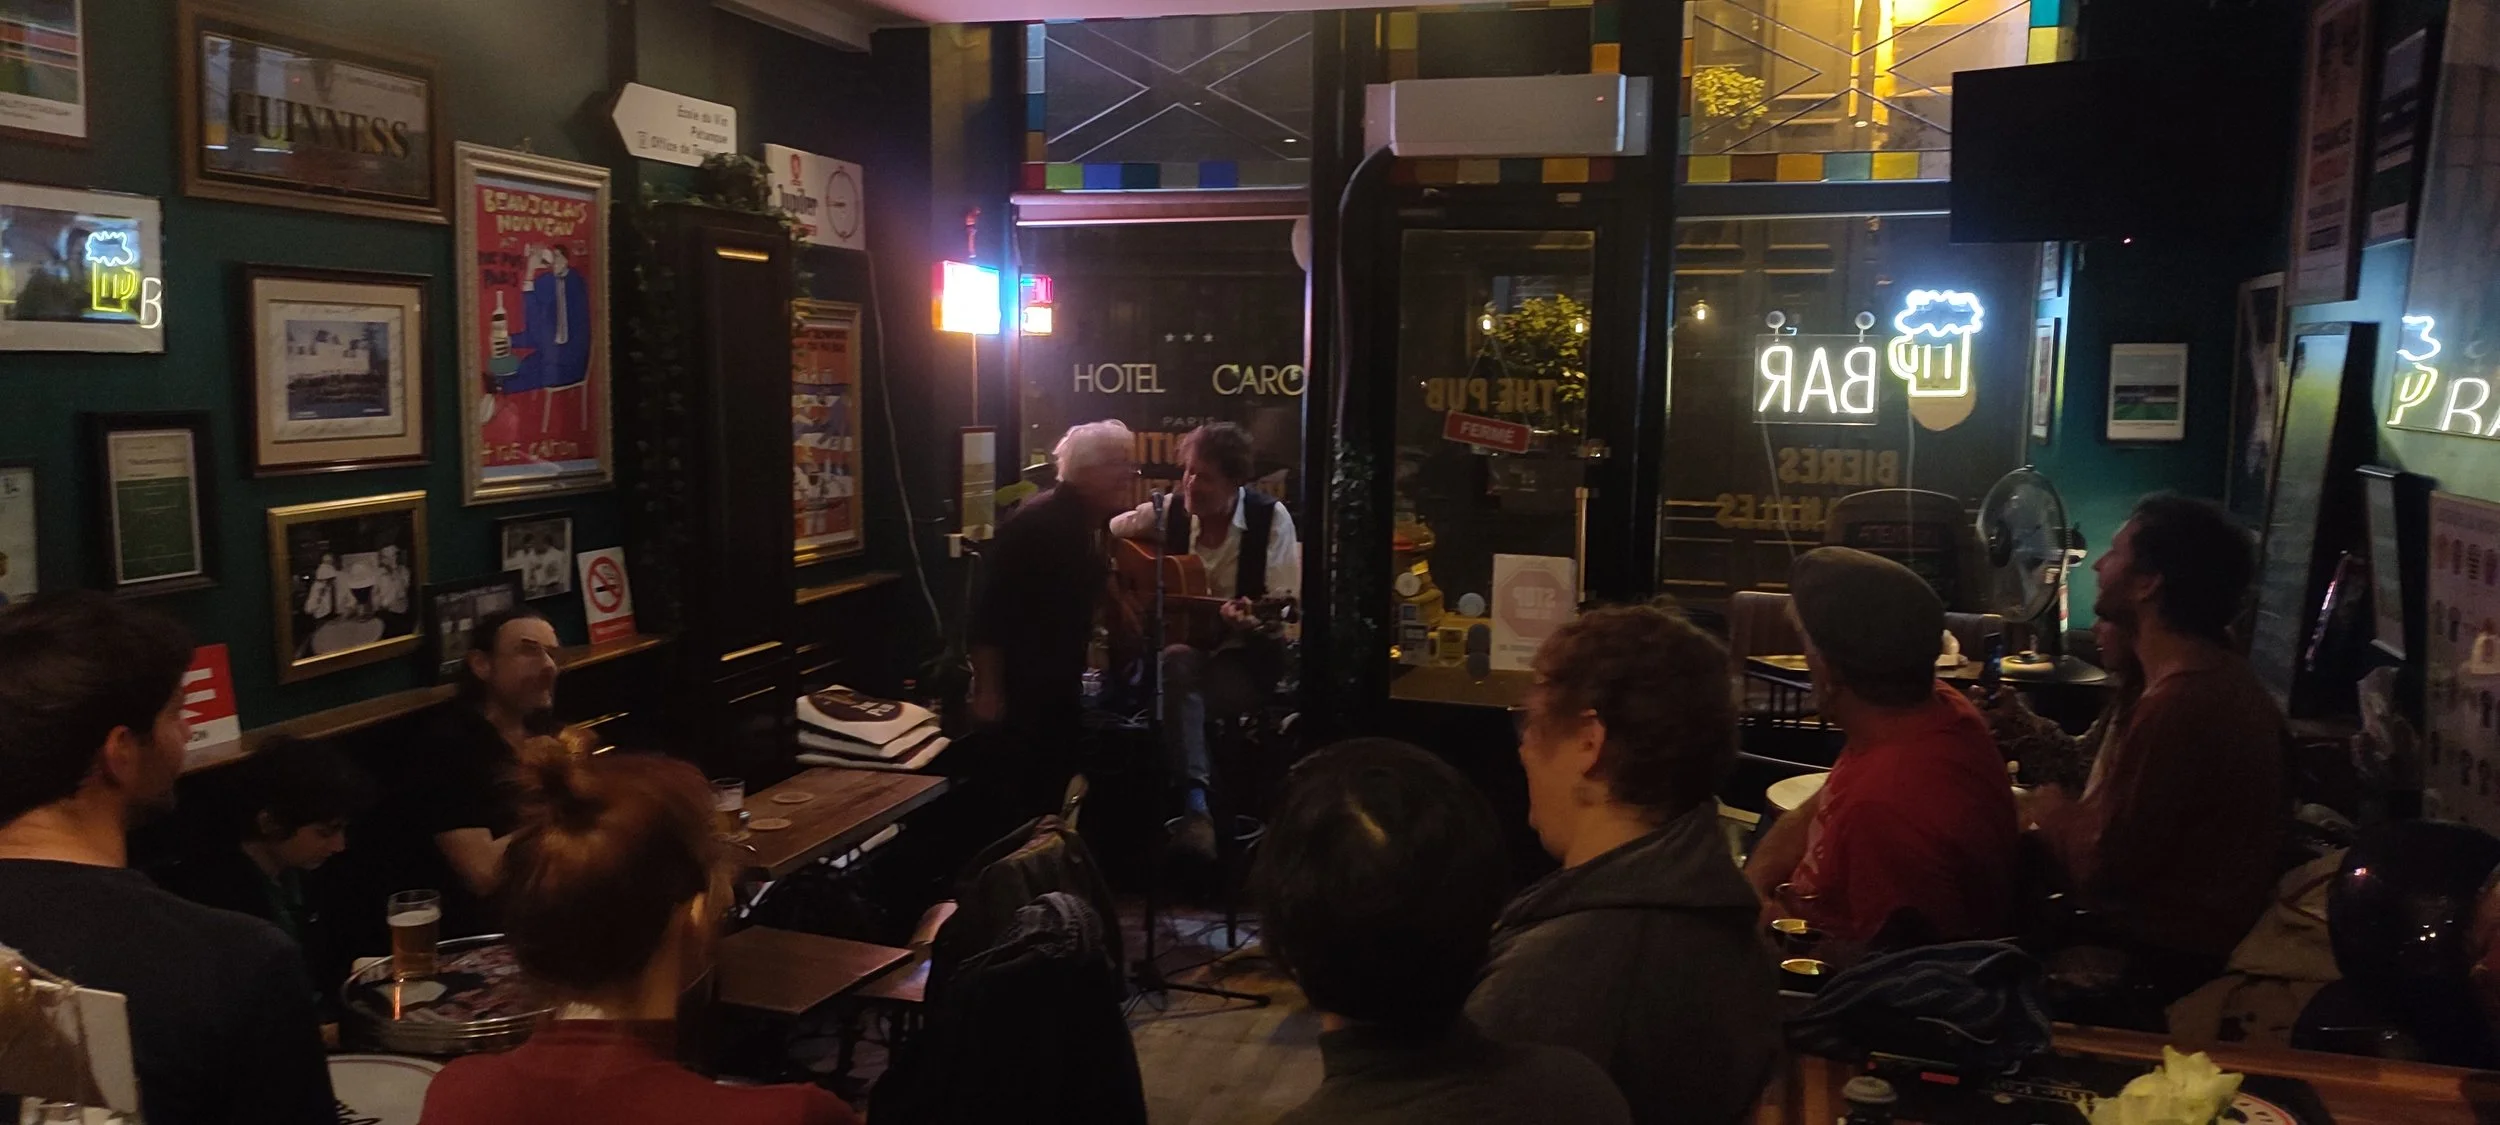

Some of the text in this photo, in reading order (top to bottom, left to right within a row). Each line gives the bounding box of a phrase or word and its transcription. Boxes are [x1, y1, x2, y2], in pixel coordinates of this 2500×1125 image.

[228, 87, 409, 160] GUINNESS
[651, 135, 677, 152] Office
[482, 188, 588, 225] BEAUJOLAIS
[495, 214, 577, 237] NOUVEAU
[1073, 363, 1167, 394] HOTEL
[1460, 420, 1517, 445] FERMÉ
